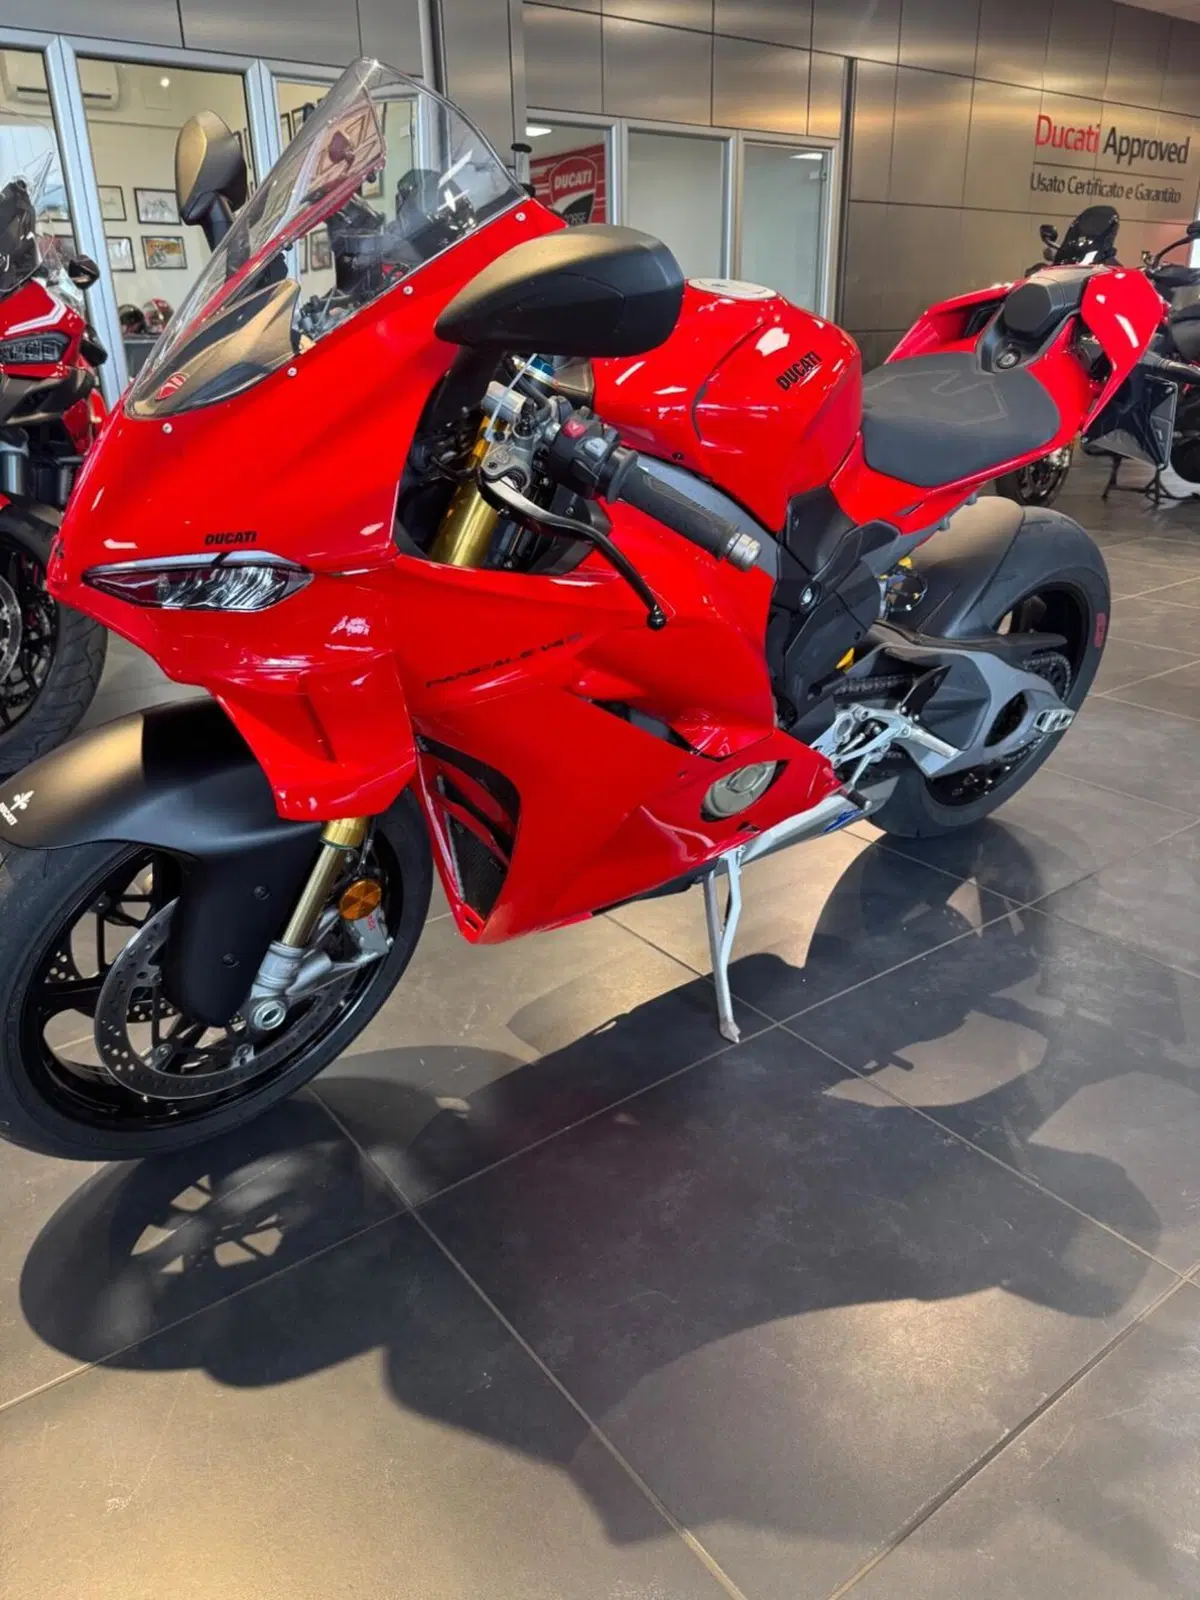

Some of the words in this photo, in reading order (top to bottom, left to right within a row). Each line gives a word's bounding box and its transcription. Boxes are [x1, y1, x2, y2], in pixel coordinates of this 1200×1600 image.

[1034, 114, 1101, 153] Ducati
[1103, 126, 1191, 166] Approved
[554, 169, 593, 190] DUCATI
[1030, 171, 1066, 194] Usato
[1067, 175, 1124, 200] Certificato
[1125, 189, 1133, 200] e
[1135, 183, 1182, 204] Garantito
[776, 351, 823, 391] DUCATI
[205, 531, 257, 546] DUCATI
